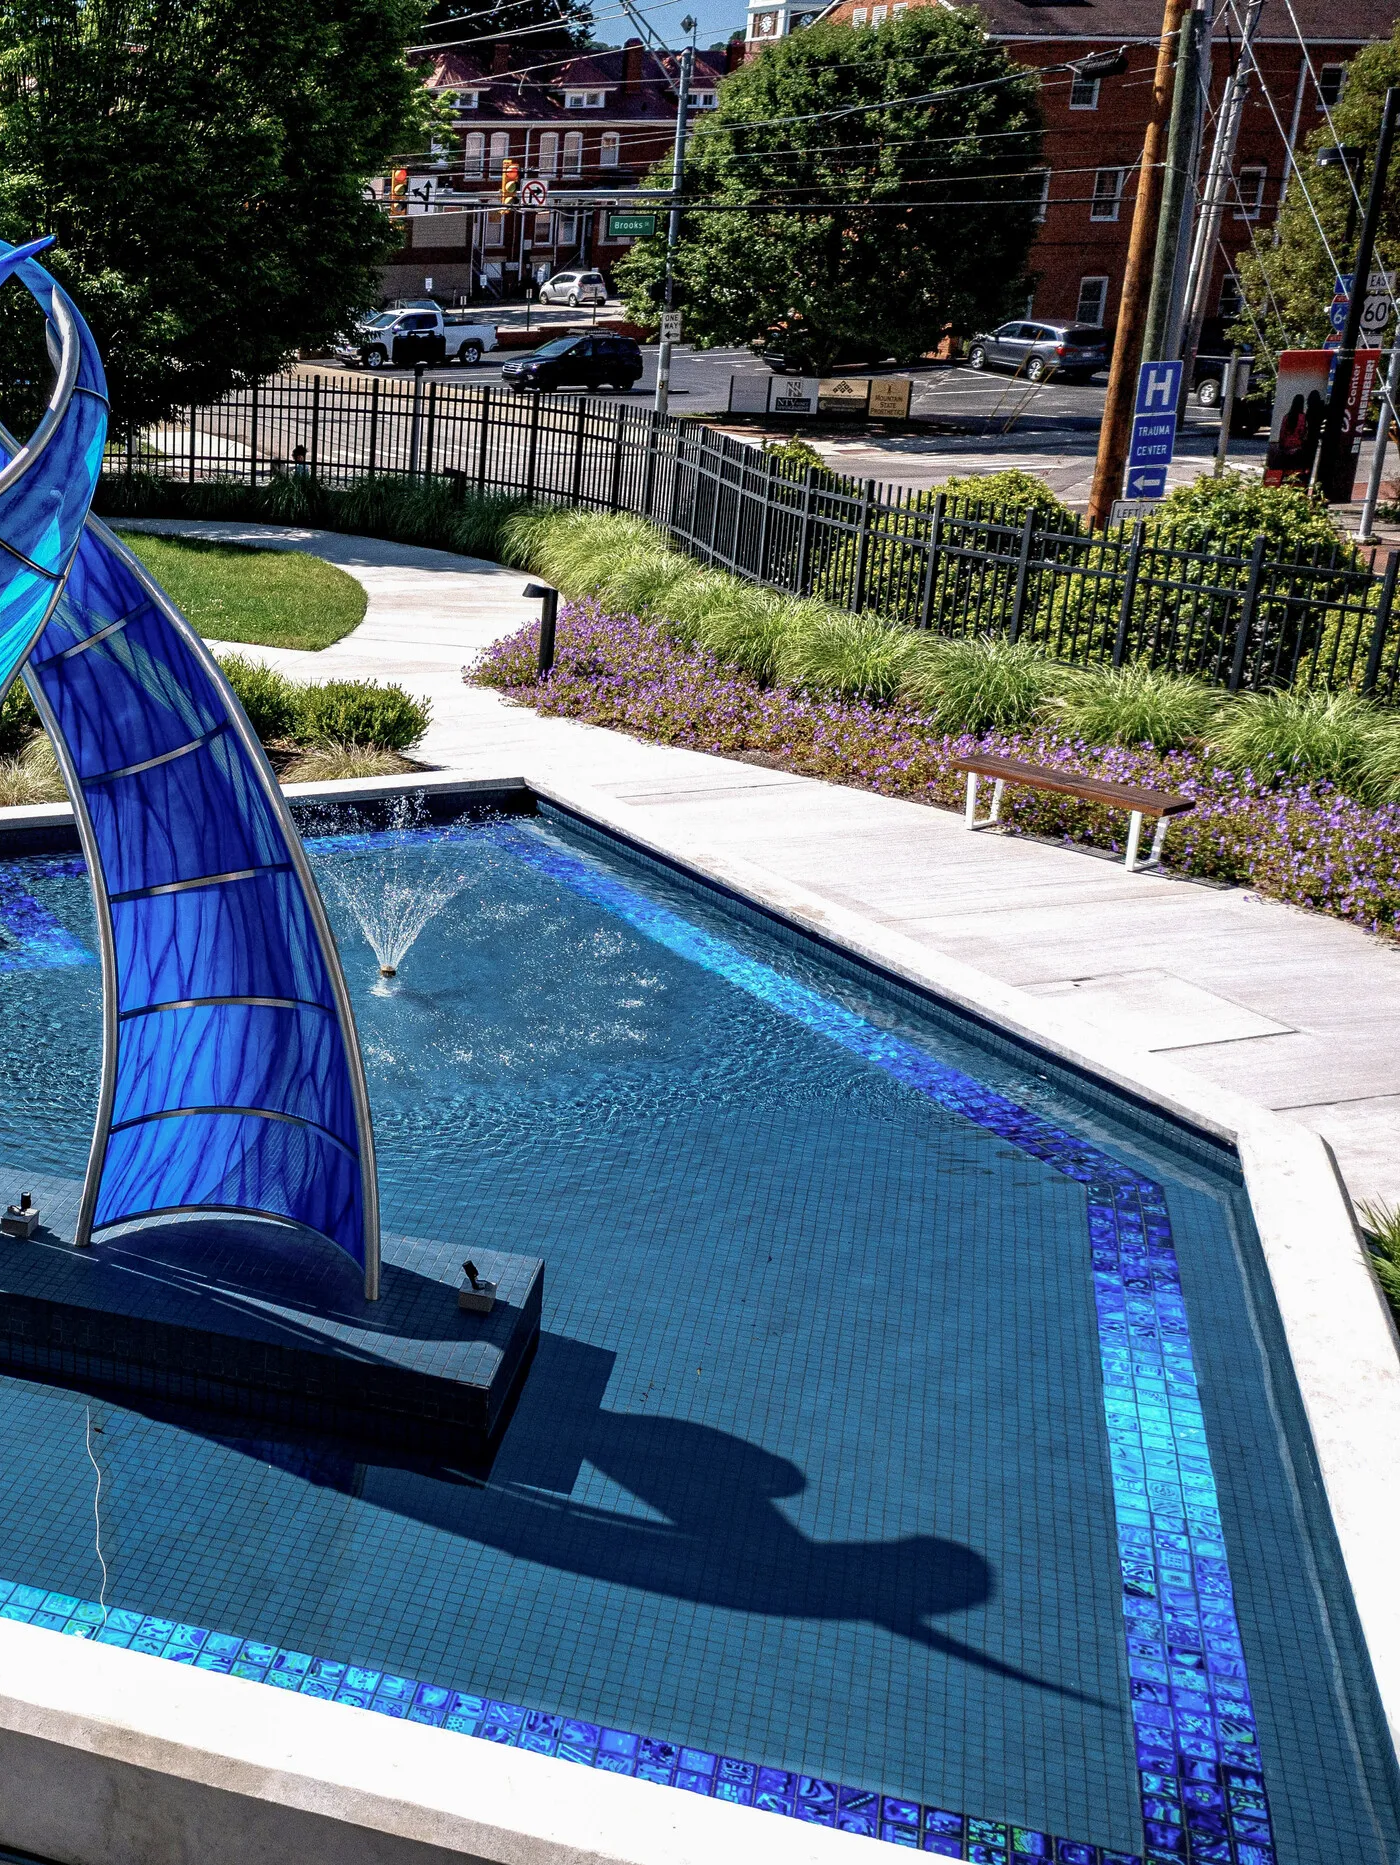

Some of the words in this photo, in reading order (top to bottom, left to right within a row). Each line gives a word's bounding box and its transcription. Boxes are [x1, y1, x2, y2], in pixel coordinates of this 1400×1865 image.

[614, 221, 643, 229] Brooks
[1370, 275, 1392, 287] EAST
[1364, 302, 1387, 322] 60
[1144, 369, 1174, 407] H
[1347, 364, 1361, 406] Center
[1357, 359, 1376, 421] MEMBER!
[777, 398, 797, 406] NTV
[875, 394, 903, 402] MOUNTAIN
[870, 407, 905, 416] PROSTHETICS
[1138, 425, 1170, 437] TRAUMA
[1355, 424, 1364, 433] A
[1136, 444, 1167, 456] CENTER
[1351, 436, 1362, 454] BE
[1117, 508, 1139, 518] LEFT
